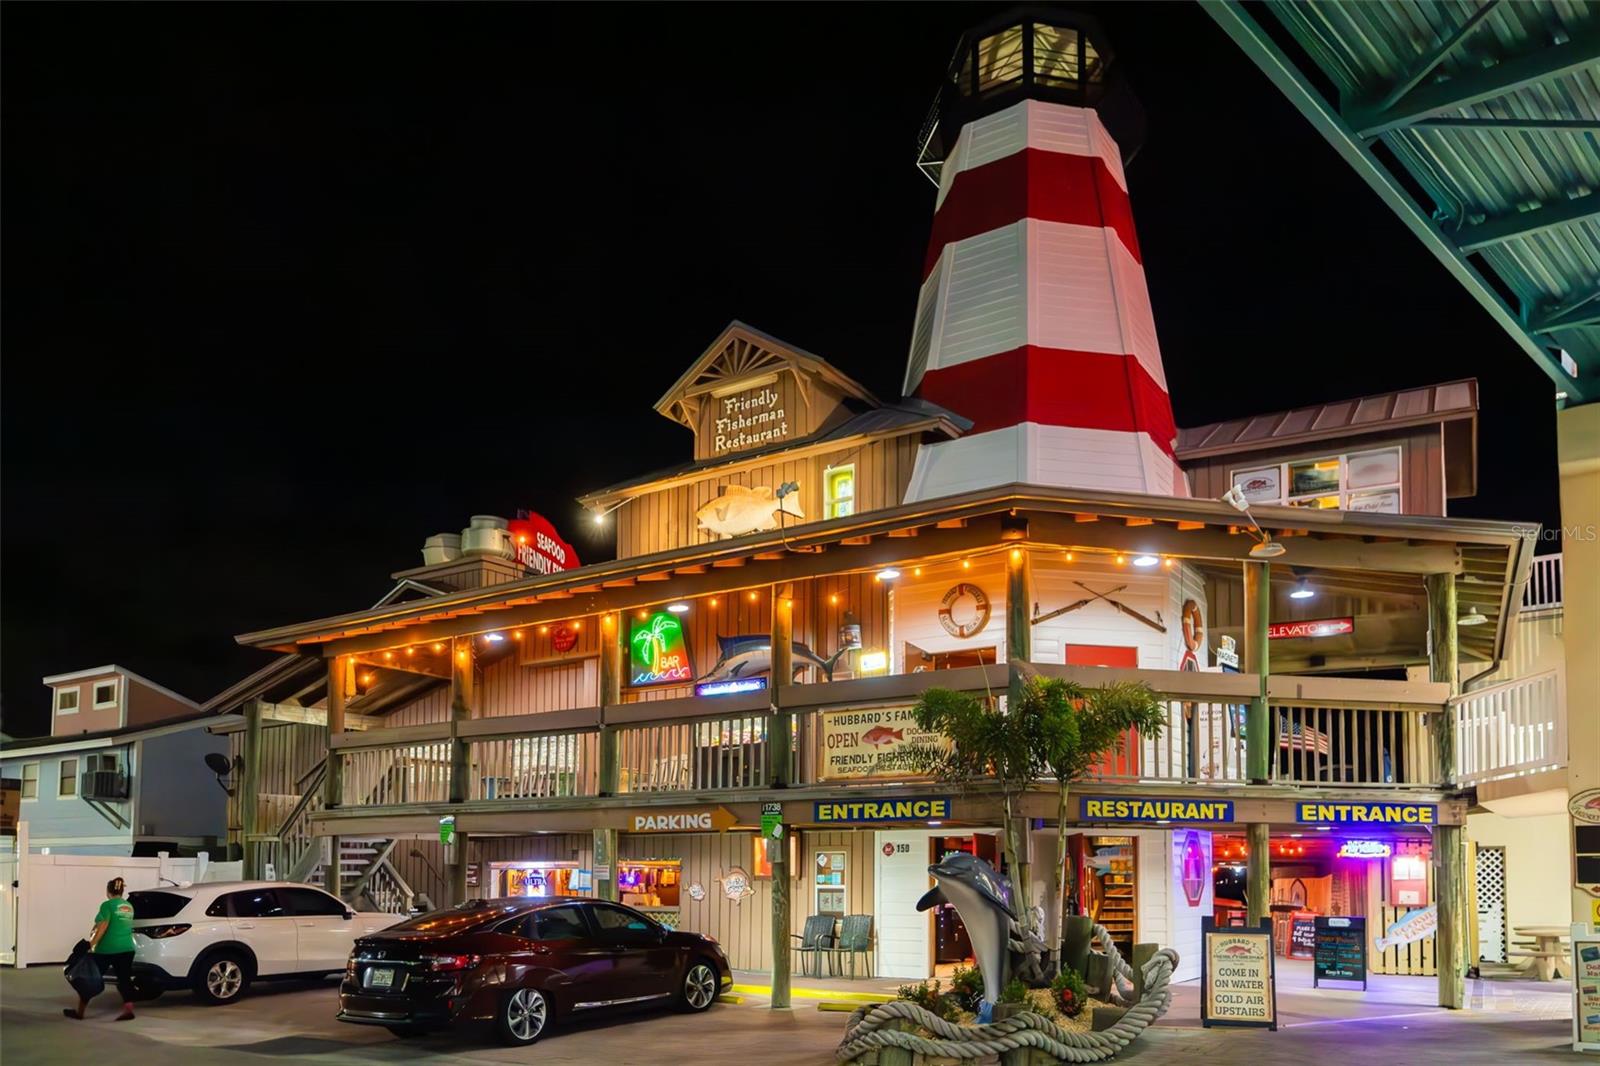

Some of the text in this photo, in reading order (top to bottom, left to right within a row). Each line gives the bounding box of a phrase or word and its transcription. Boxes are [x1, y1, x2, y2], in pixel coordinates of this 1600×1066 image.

[724, 389, 778, 414] Friendly
[715, 409, 784, 433] Fisherman
[715, 422, 788, 451] Restaurant
[537, 532, 565, 565] SEAFOOD
[518, 543, 552, 575] FRIENDLY
[1268, 623, 1323, 637] ELEVATO
[660, 655, 680, 668] BAR
[827, 732, 859, 749] OPEN
[911, 735, 938, 744] DINING
[830, 753, 874, 766] FRIENDLY
[818, 800, 945, 820] ENTRANCE
[1087, 800, 1228, 820] RESTAURANT
[1302, 804, 1433, 823] ENTRANCE
[635, 813, 712, 830] PARKING
[1218, 967, 1259, 978] COME IN
[1214, 979, 1264, 990] ON WATER
[1215, 994, 1265, 1005] COLD AIR
[1215, 1006, 1266, 1017] UPSTAIRS
